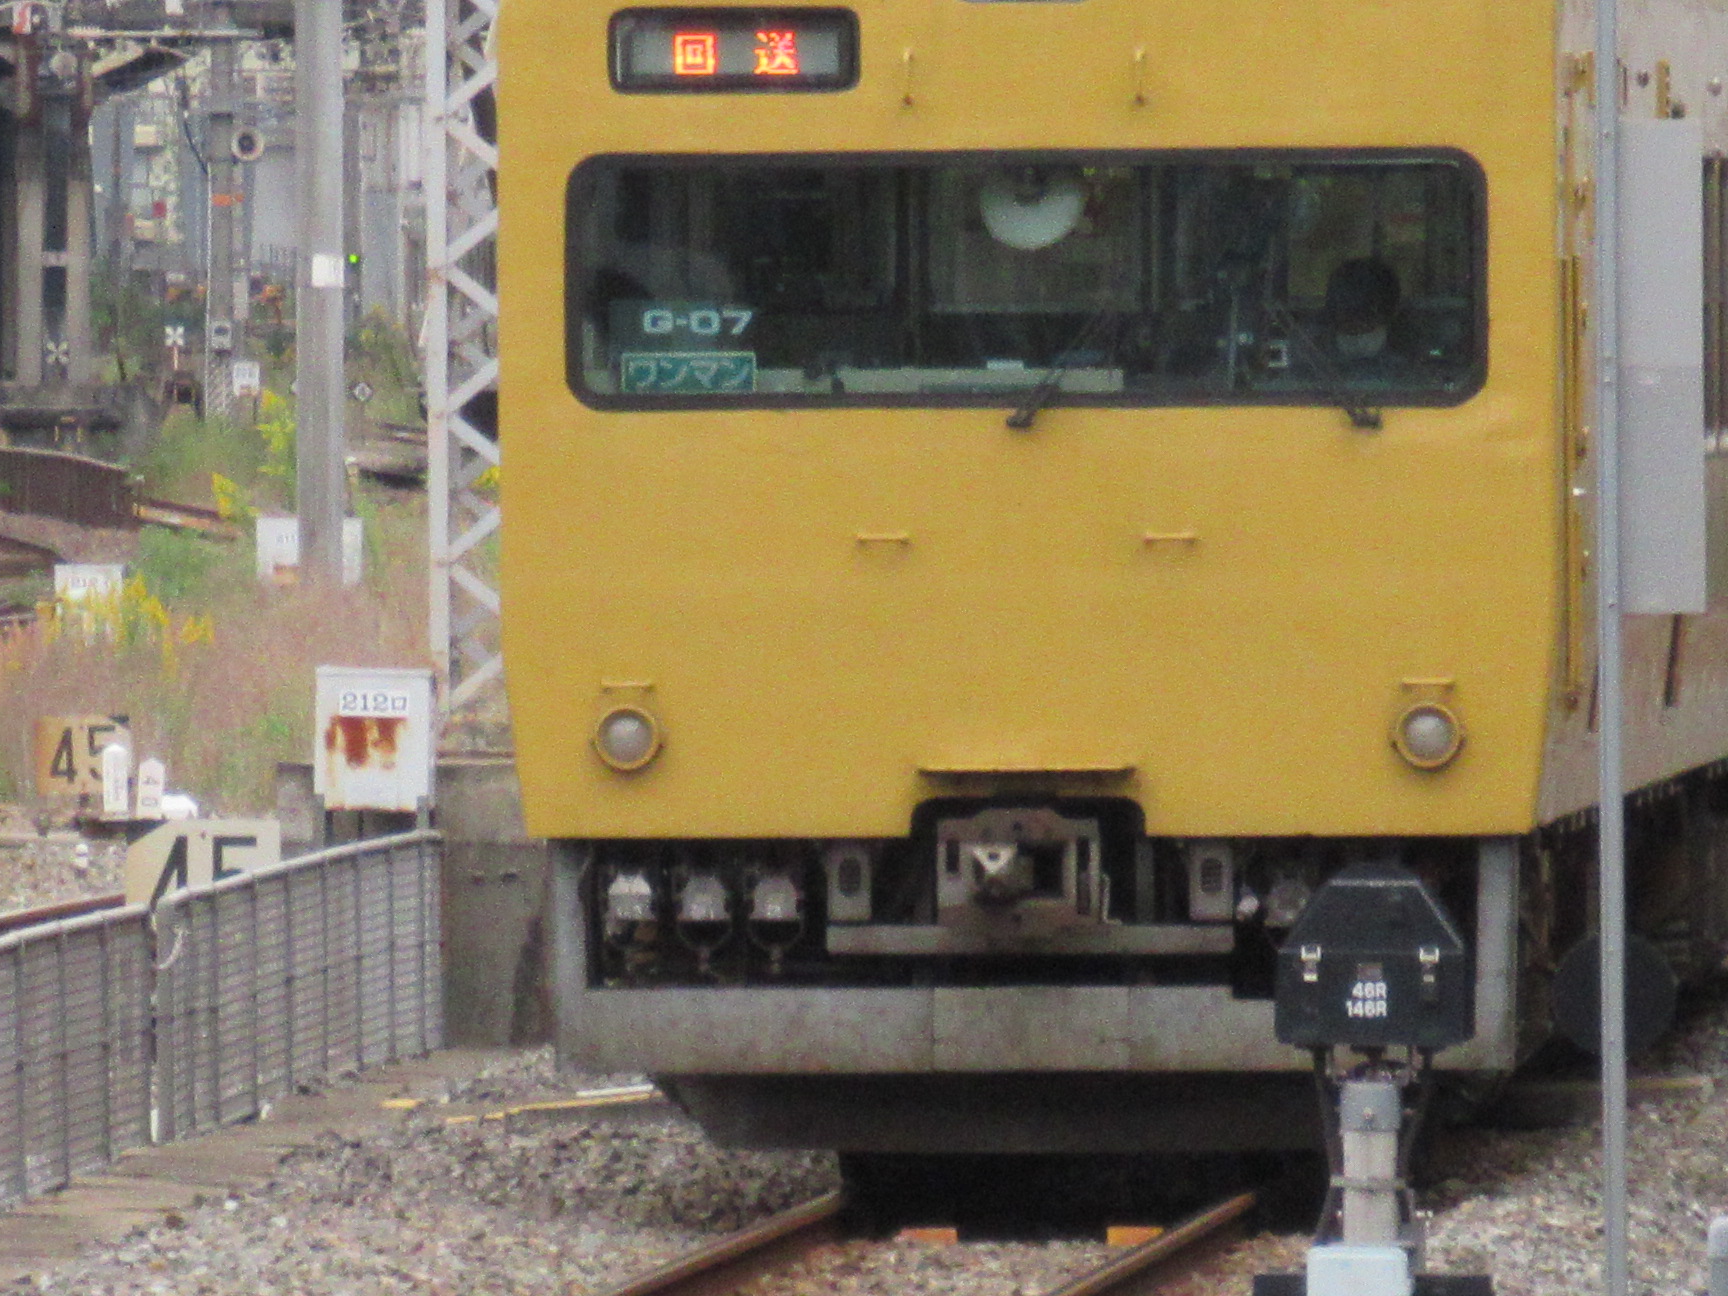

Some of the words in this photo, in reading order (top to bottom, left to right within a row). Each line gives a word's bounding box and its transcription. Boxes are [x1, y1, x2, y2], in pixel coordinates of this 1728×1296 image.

[674, 30, 800, 75] 回送
[643, 309, 753, 335] G-07
[628, 358, 750, 391] ワンマン
[1346, 1000, 1387, 1018] 146R
